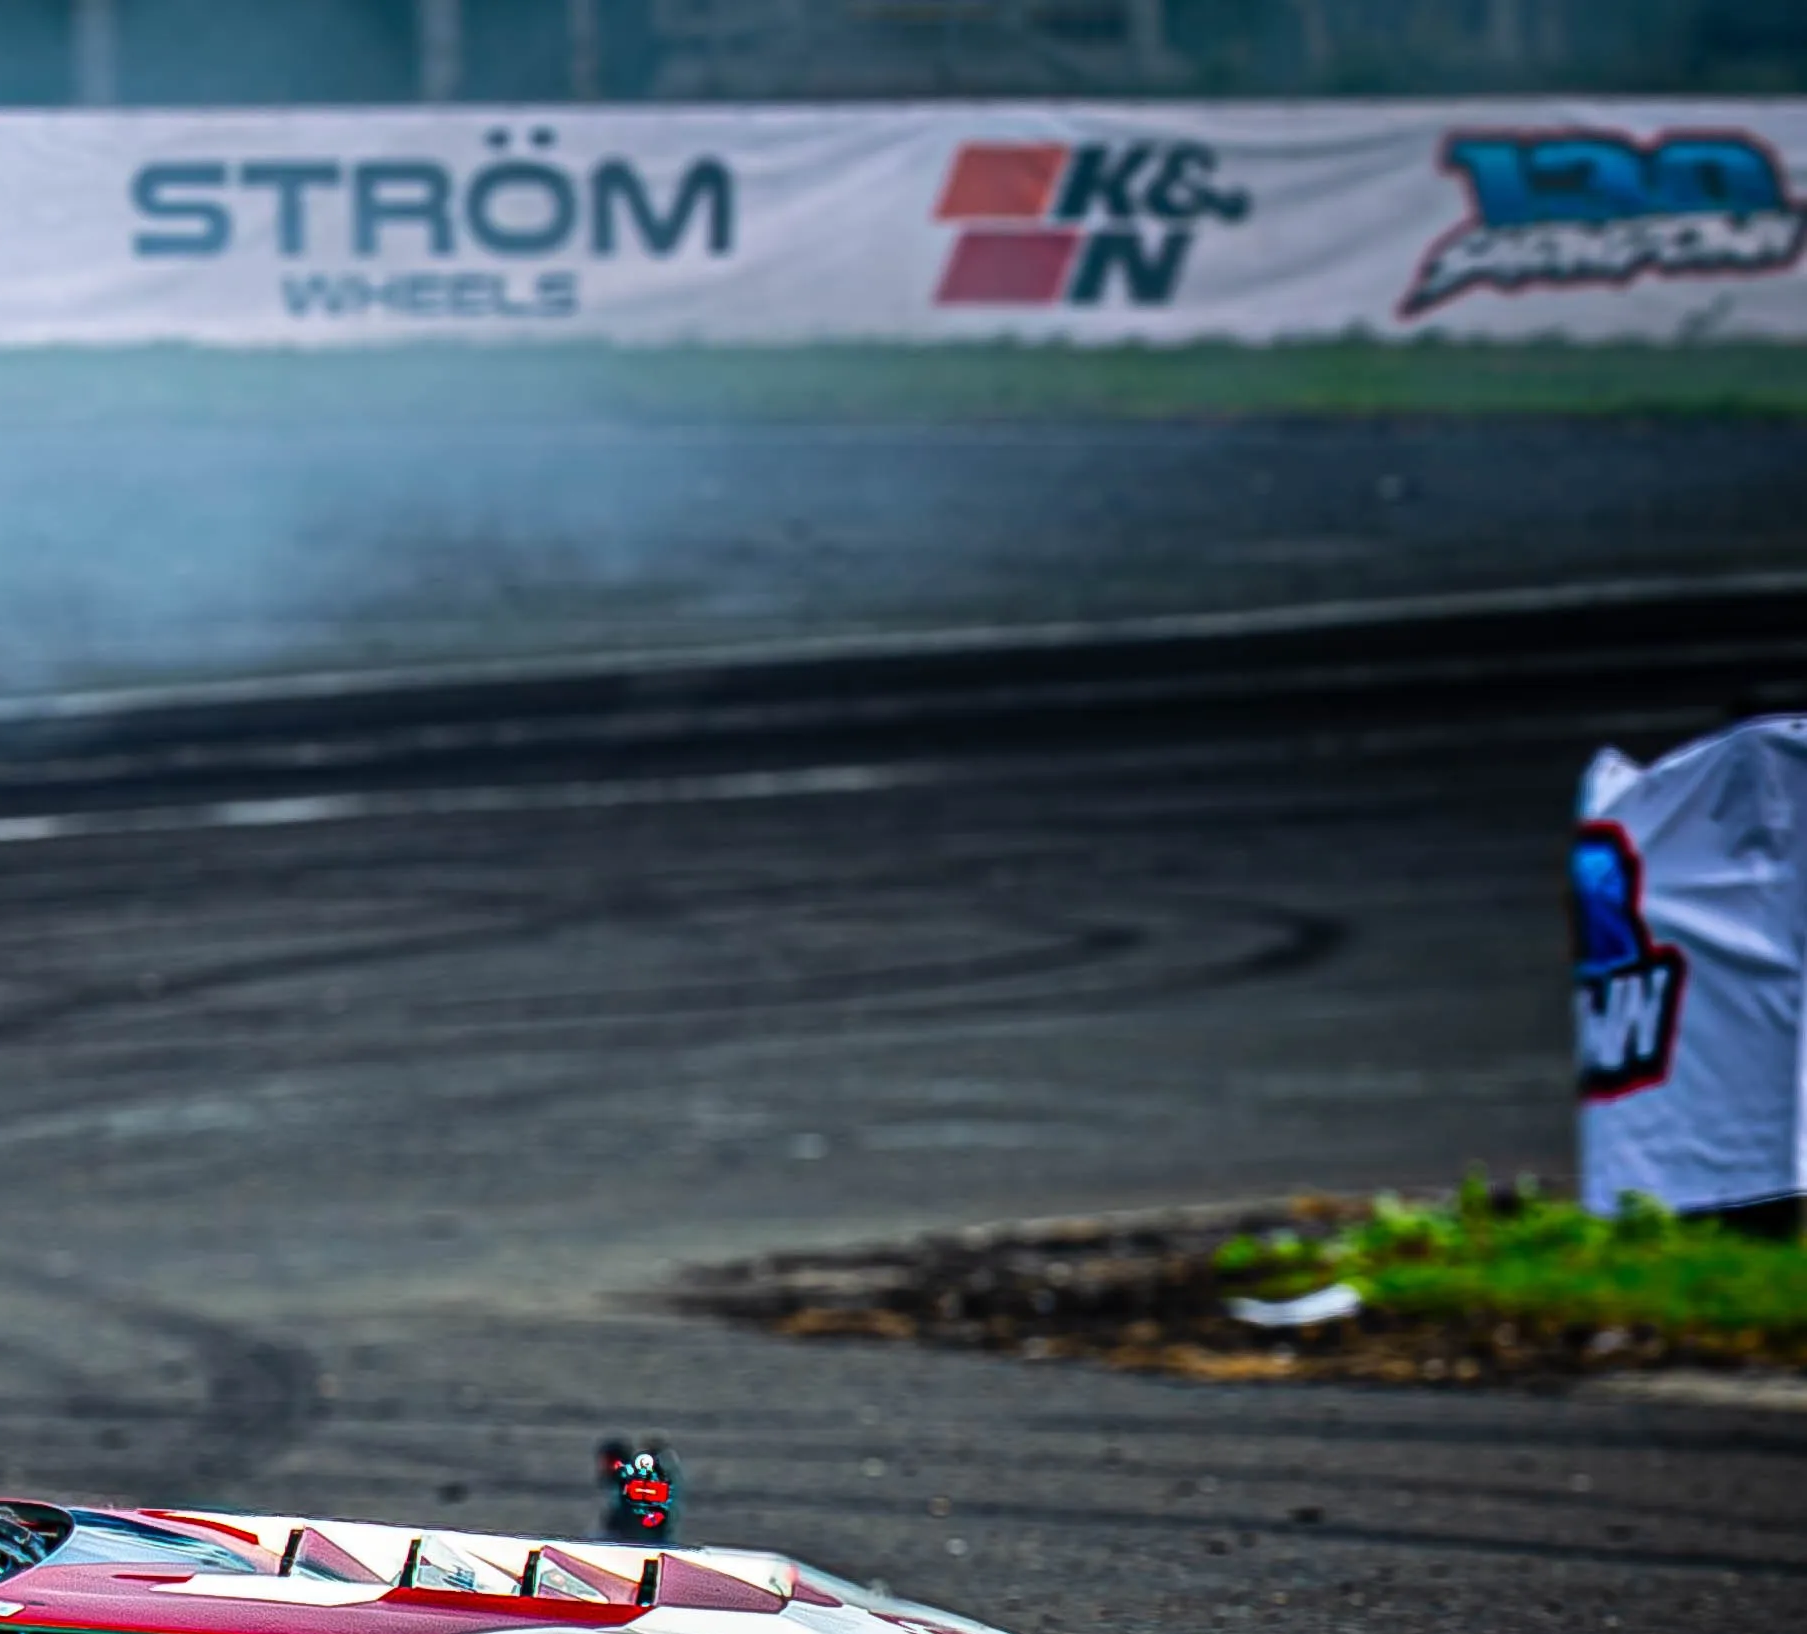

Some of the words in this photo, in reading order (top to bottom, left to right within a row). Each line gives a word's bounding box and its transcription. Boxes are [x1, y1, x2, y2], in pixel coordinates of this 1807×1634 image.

[129, 127, 736, 259] STRÖM
[1449, 139, 1782, 228] 130
[280, 271, 578, 319] WHEELS
